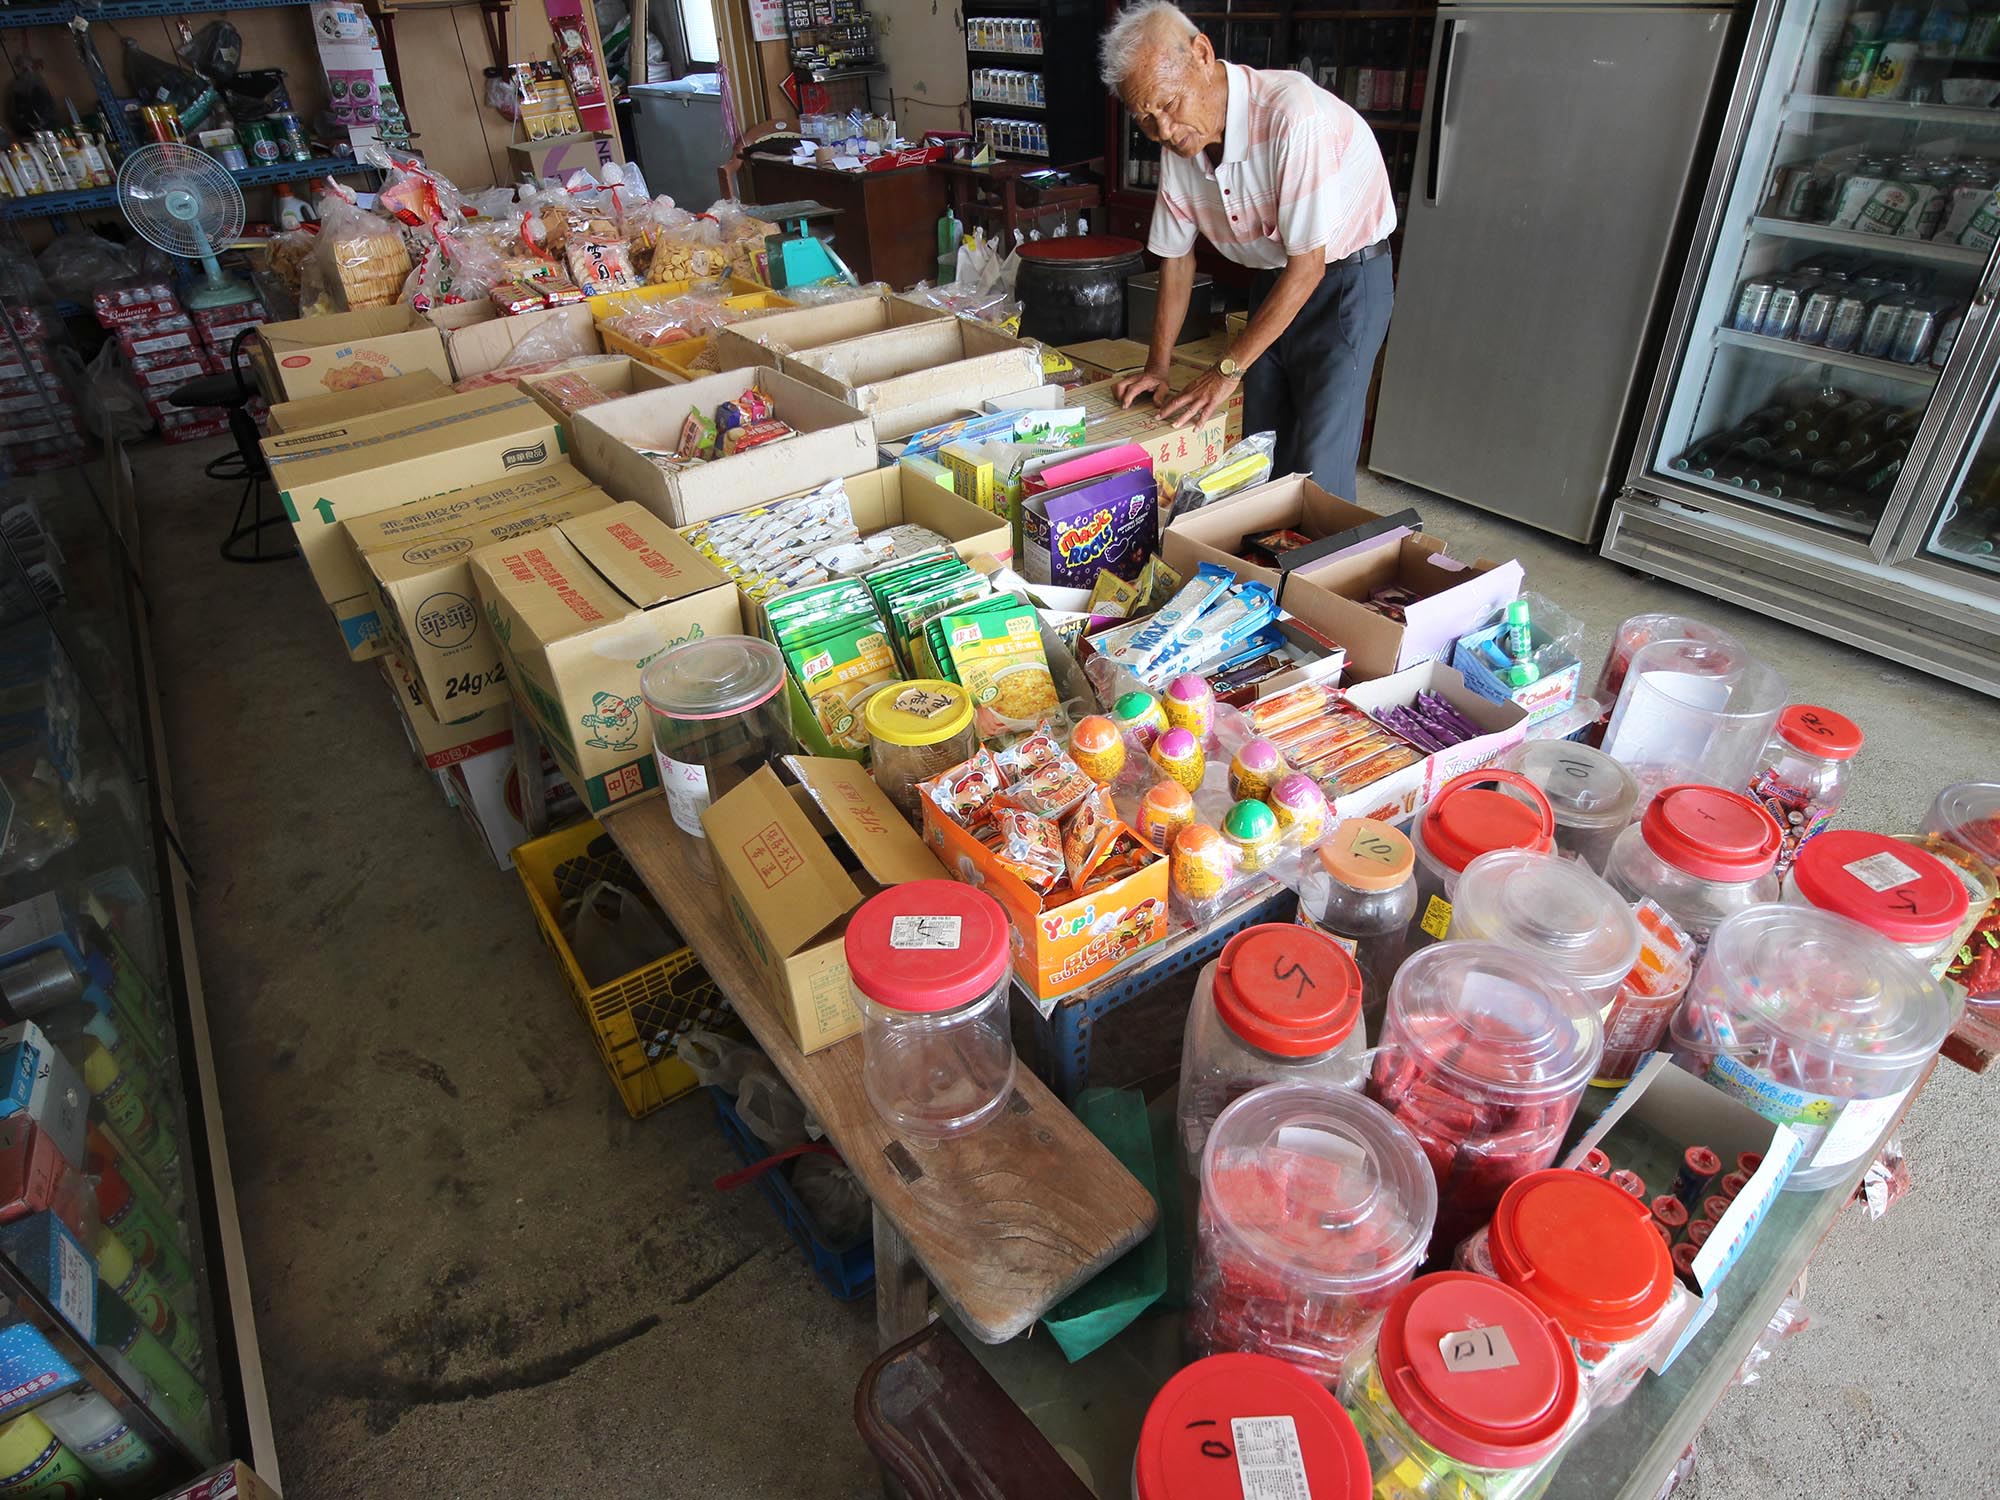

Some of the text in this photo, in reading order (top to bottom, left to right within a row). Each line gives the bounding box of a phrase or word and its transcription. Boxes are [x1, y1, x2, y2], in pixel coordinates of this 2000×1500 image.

[108, 305, 153, 320] Budweiser
[504, 447, 545, 466] 聯華食品
[1059, 508, 1112, 554] MAGIC
[1067, 525, 1113, 567] ROCKS
[420, 603, 474, 638] 乖乖
[1131, 620, 1174, 651] MAX
[806, 655, 830, 677] 康寶
[608, 778, 622, 792] 中
[624, 767, 638, 780] 20
[628, 778, 642, 790] 入
[1766, 784, 1796, 802] mentos
[1768, 801, 1784, 827] mentos
[766, 828, 798, 870] 保存方式
[1043, 905, 1095, 941] Yupi
[1049, 940, 1122, 985] BURGER
[1063, 933, 1108, 973] BIG
[1186, 1420, 1232, 1458] 10
